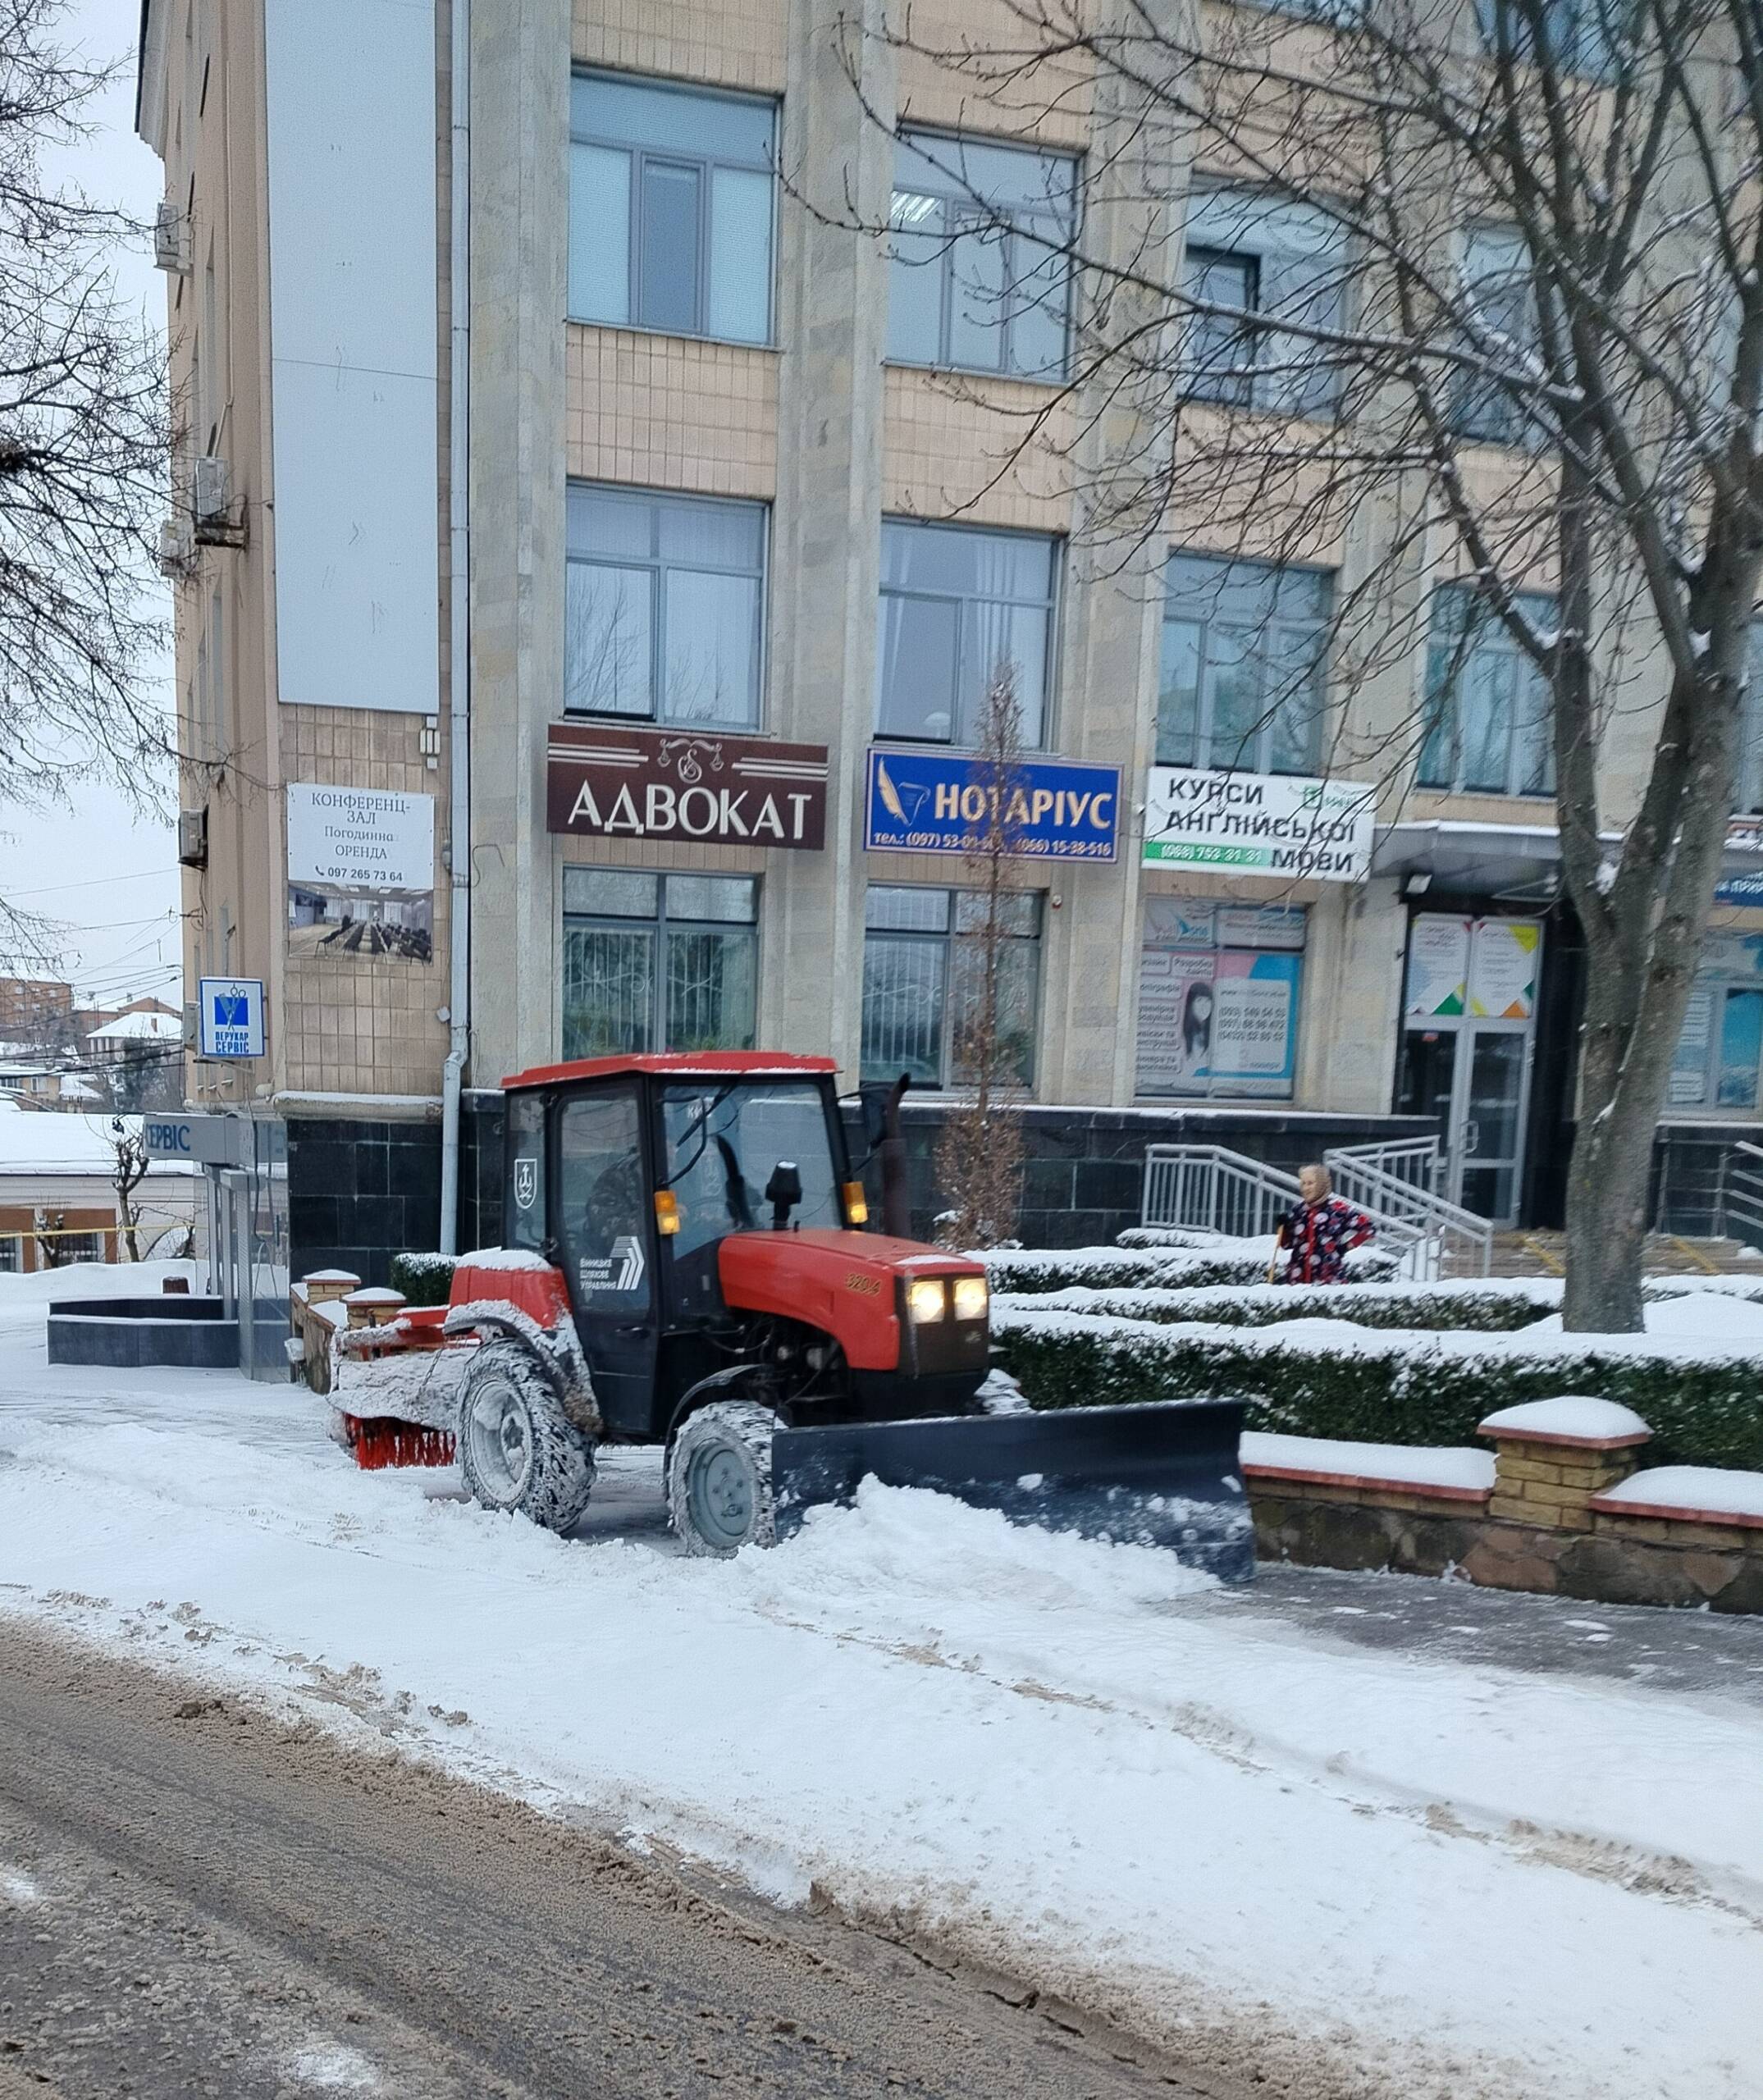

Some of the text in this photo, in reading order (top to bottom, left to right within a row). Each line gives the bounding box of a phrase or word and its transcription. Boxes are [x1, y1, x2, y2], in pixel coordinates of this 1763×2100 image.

[1168, 777, 1263, 805] КУРСИ
[312, 792, 410, 815] КОНФЕРЕНЦ-
[567, 778, 812, 840] АДВОКАТ
[347, 810, 376, 824] ЗАЛ
[325, 826, 394, 842] Погодинна
[336, 844, 388, 860] ОРЕНДА
[1272, 848, 1352, 872] МОВИ
[328, 867, 403, 882] 097 265 73 64
[215, 1041, 249, 1053] СЕРВІС
